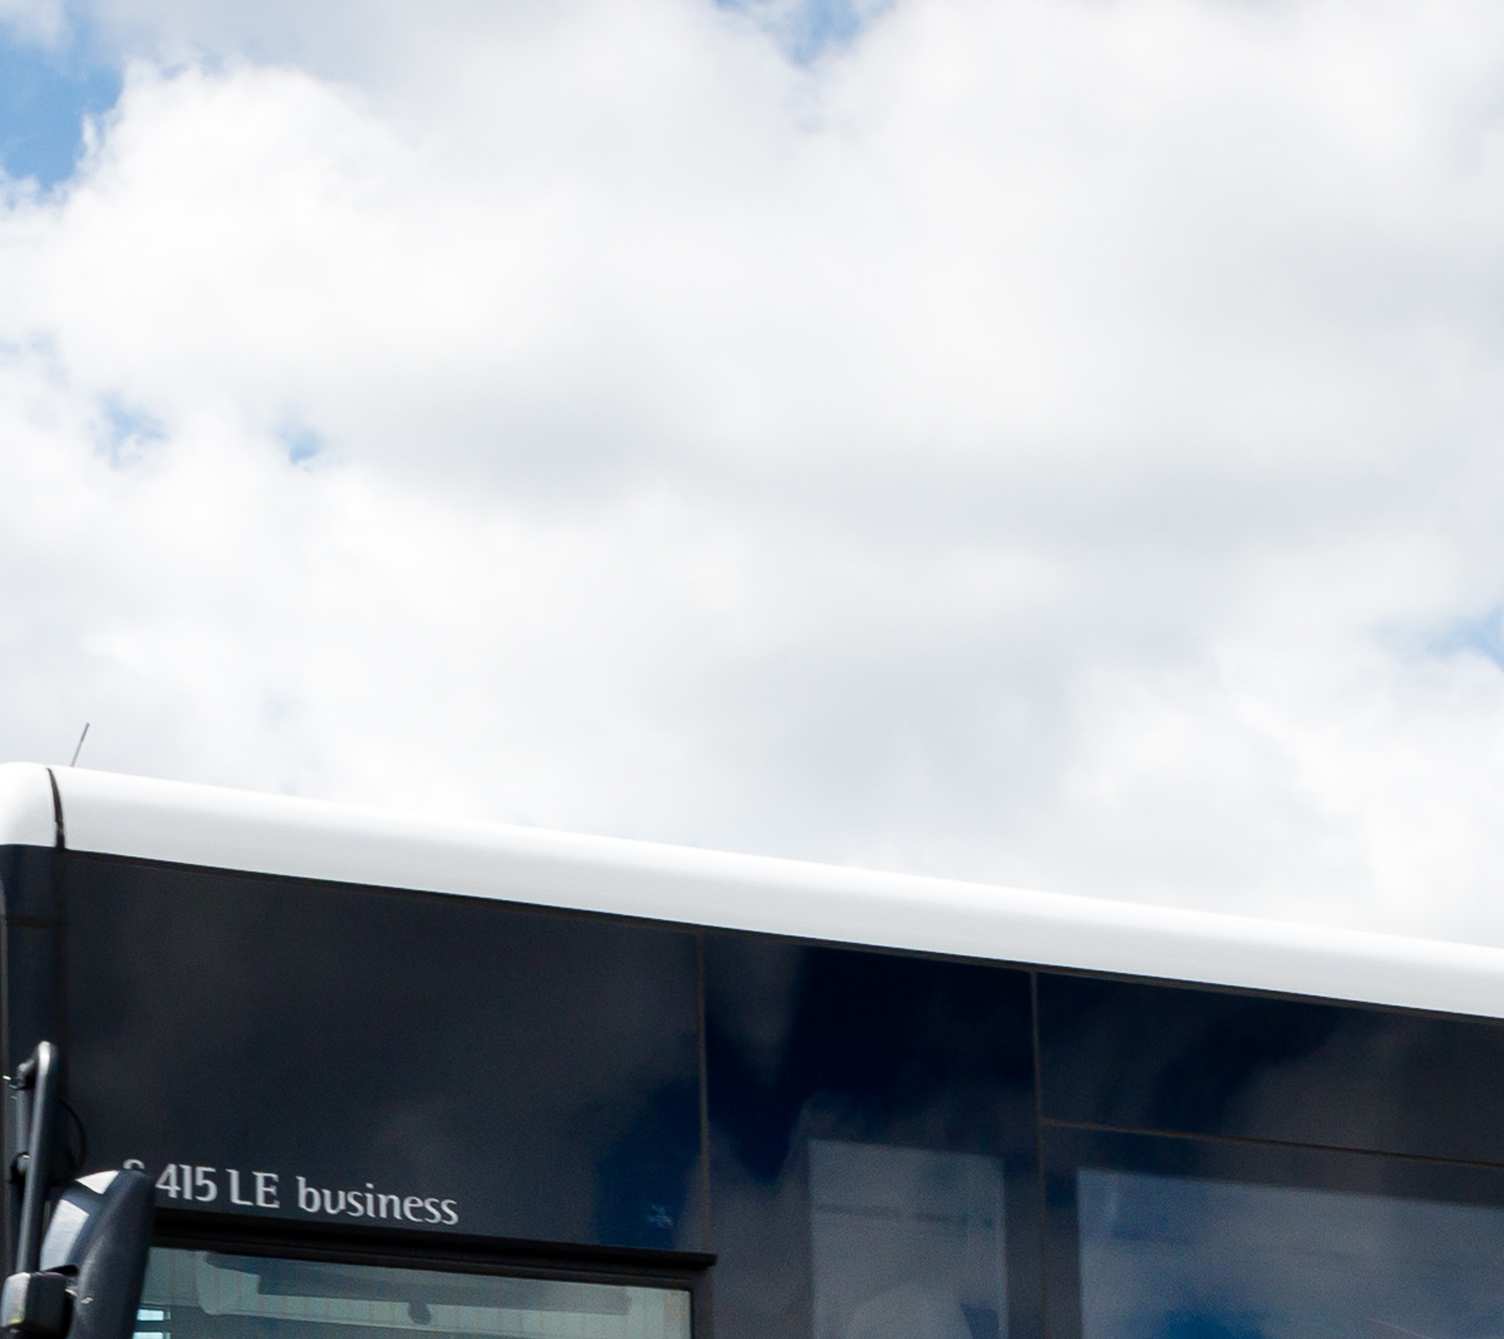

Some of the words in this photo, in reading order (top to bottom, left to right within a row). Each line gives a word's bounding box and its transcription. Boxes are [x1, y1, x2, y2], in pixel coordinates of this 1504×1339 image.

[155, 1163, 218, 1202] 415
[227, 1169, 280, 1209] LE
[297, 1176, 459, 1226] business
